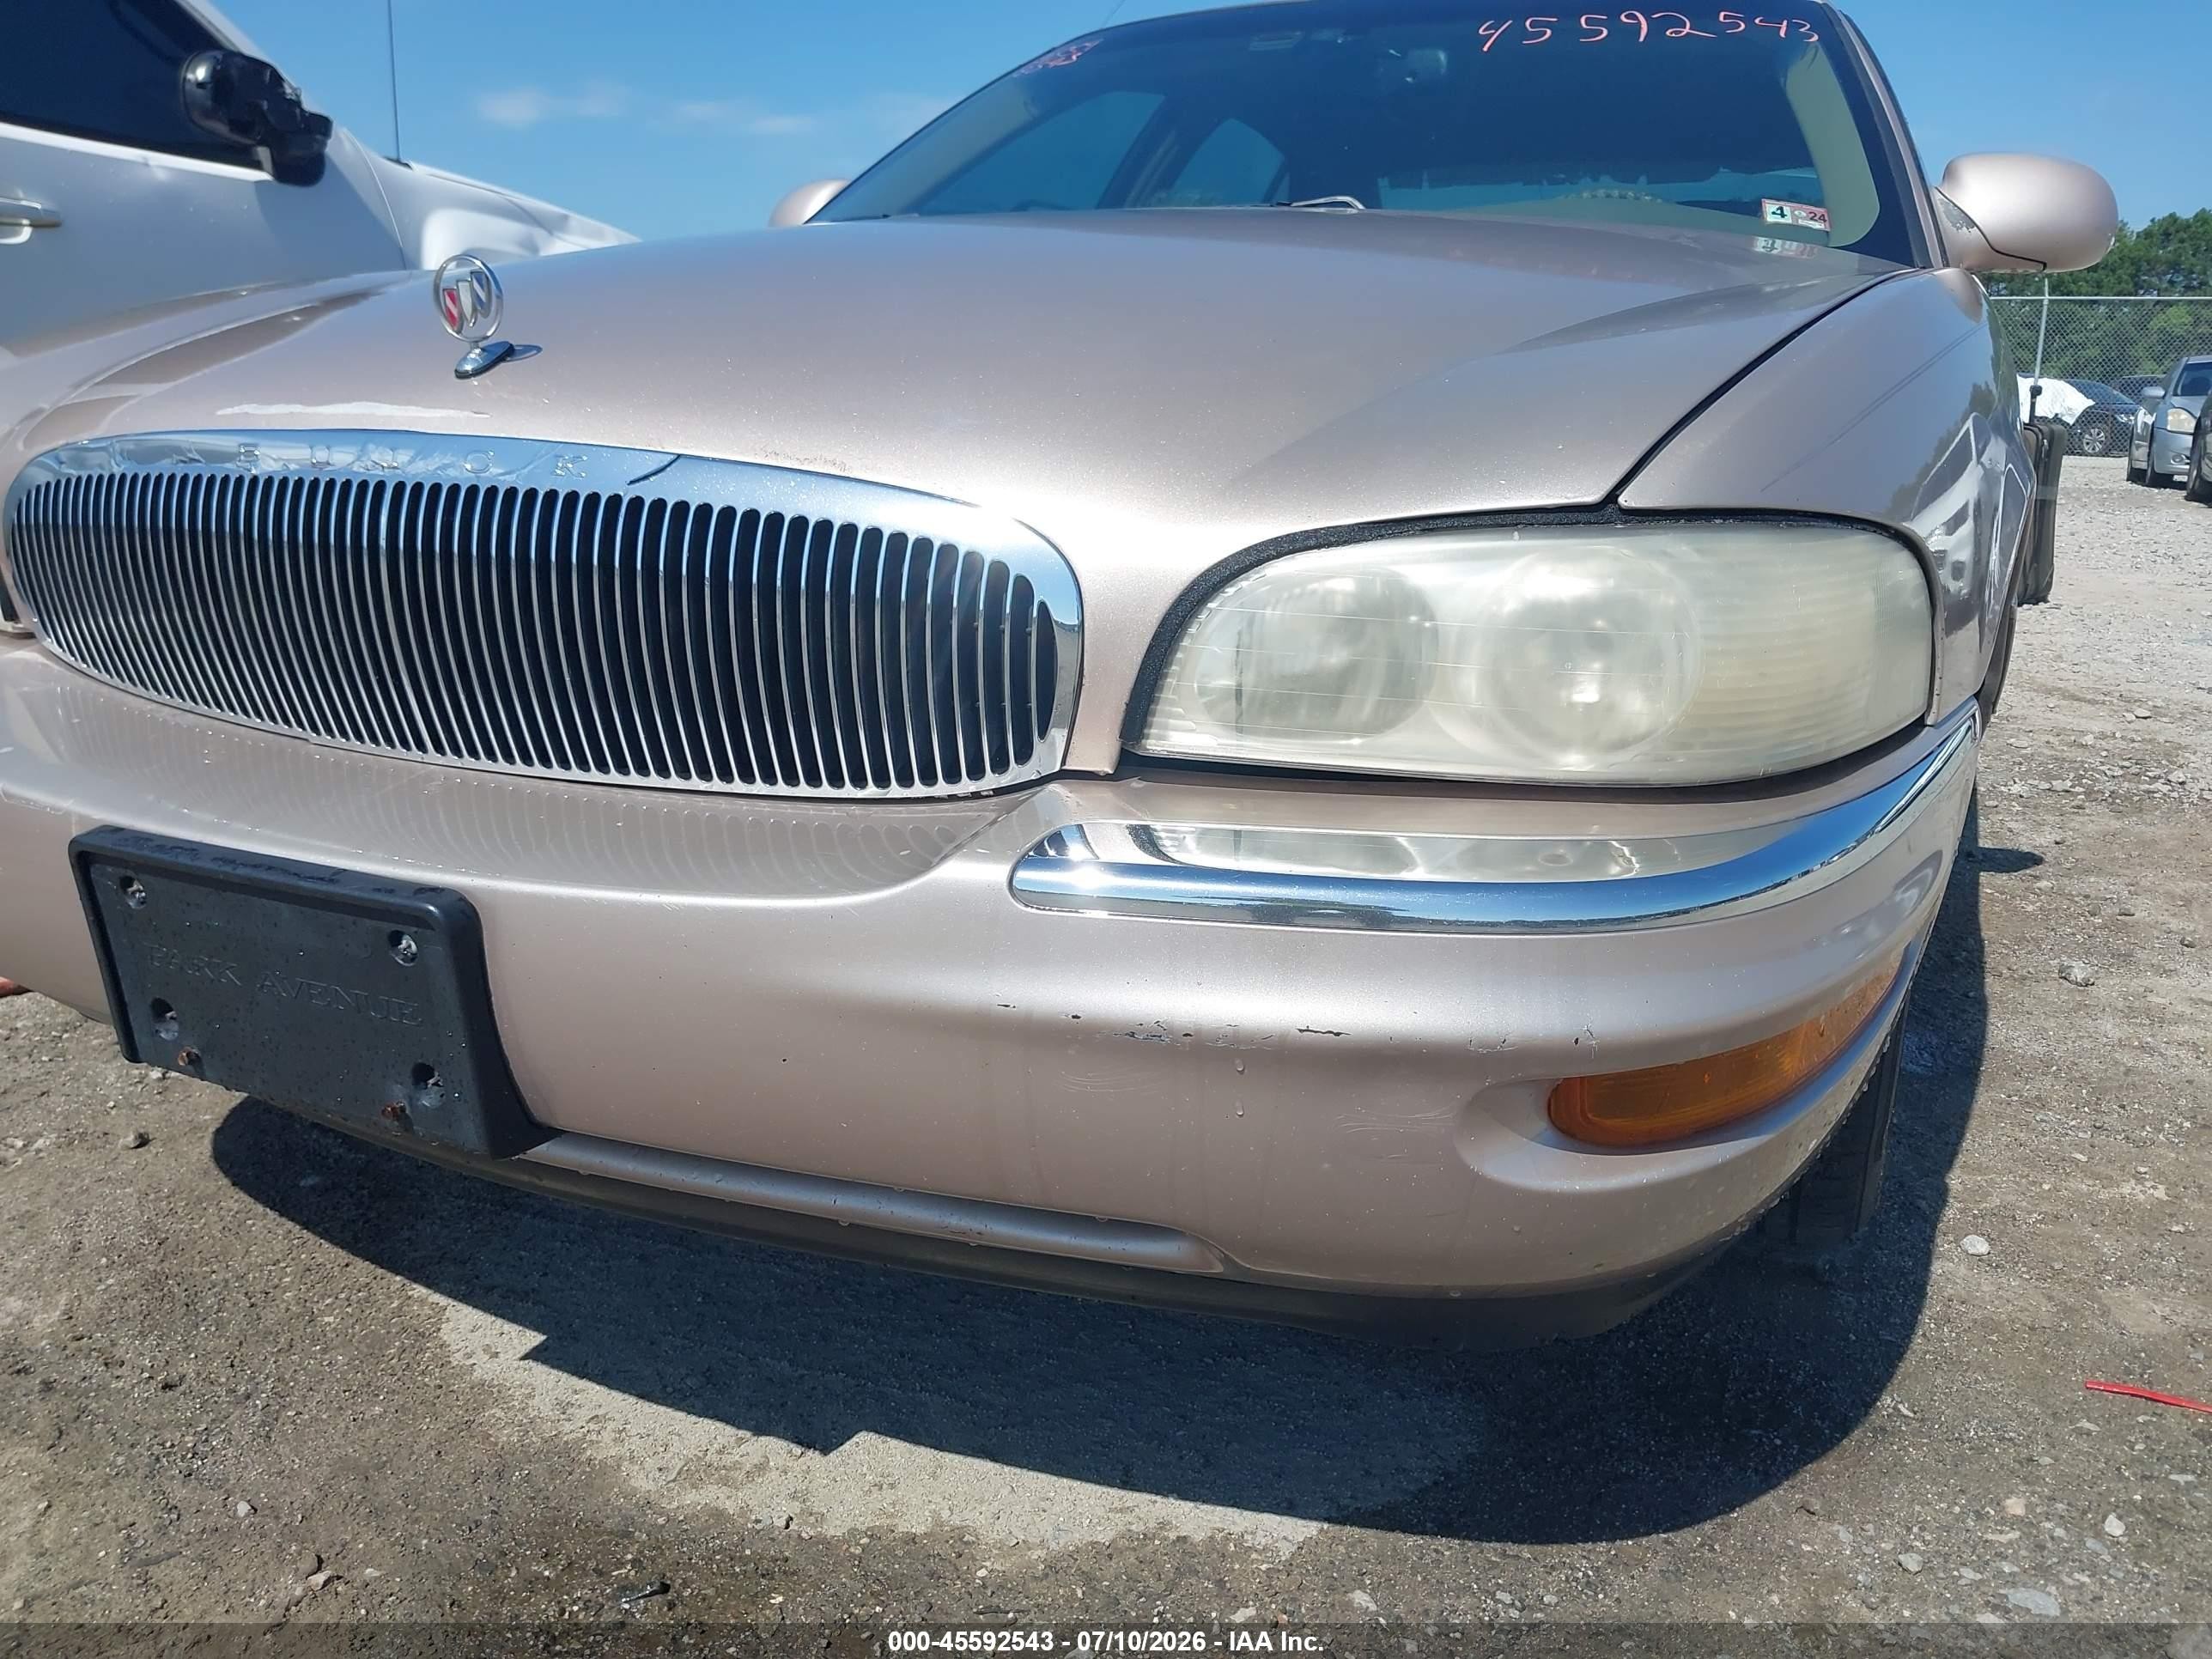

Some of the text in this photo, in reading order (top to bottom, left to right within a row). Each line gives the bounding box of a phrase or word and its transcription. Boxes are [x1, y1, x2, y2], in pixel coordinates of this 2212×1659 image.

[1771, 206, 1827, 222] 4 24
[149, 943, 422, 1026] PARK AVENUE
